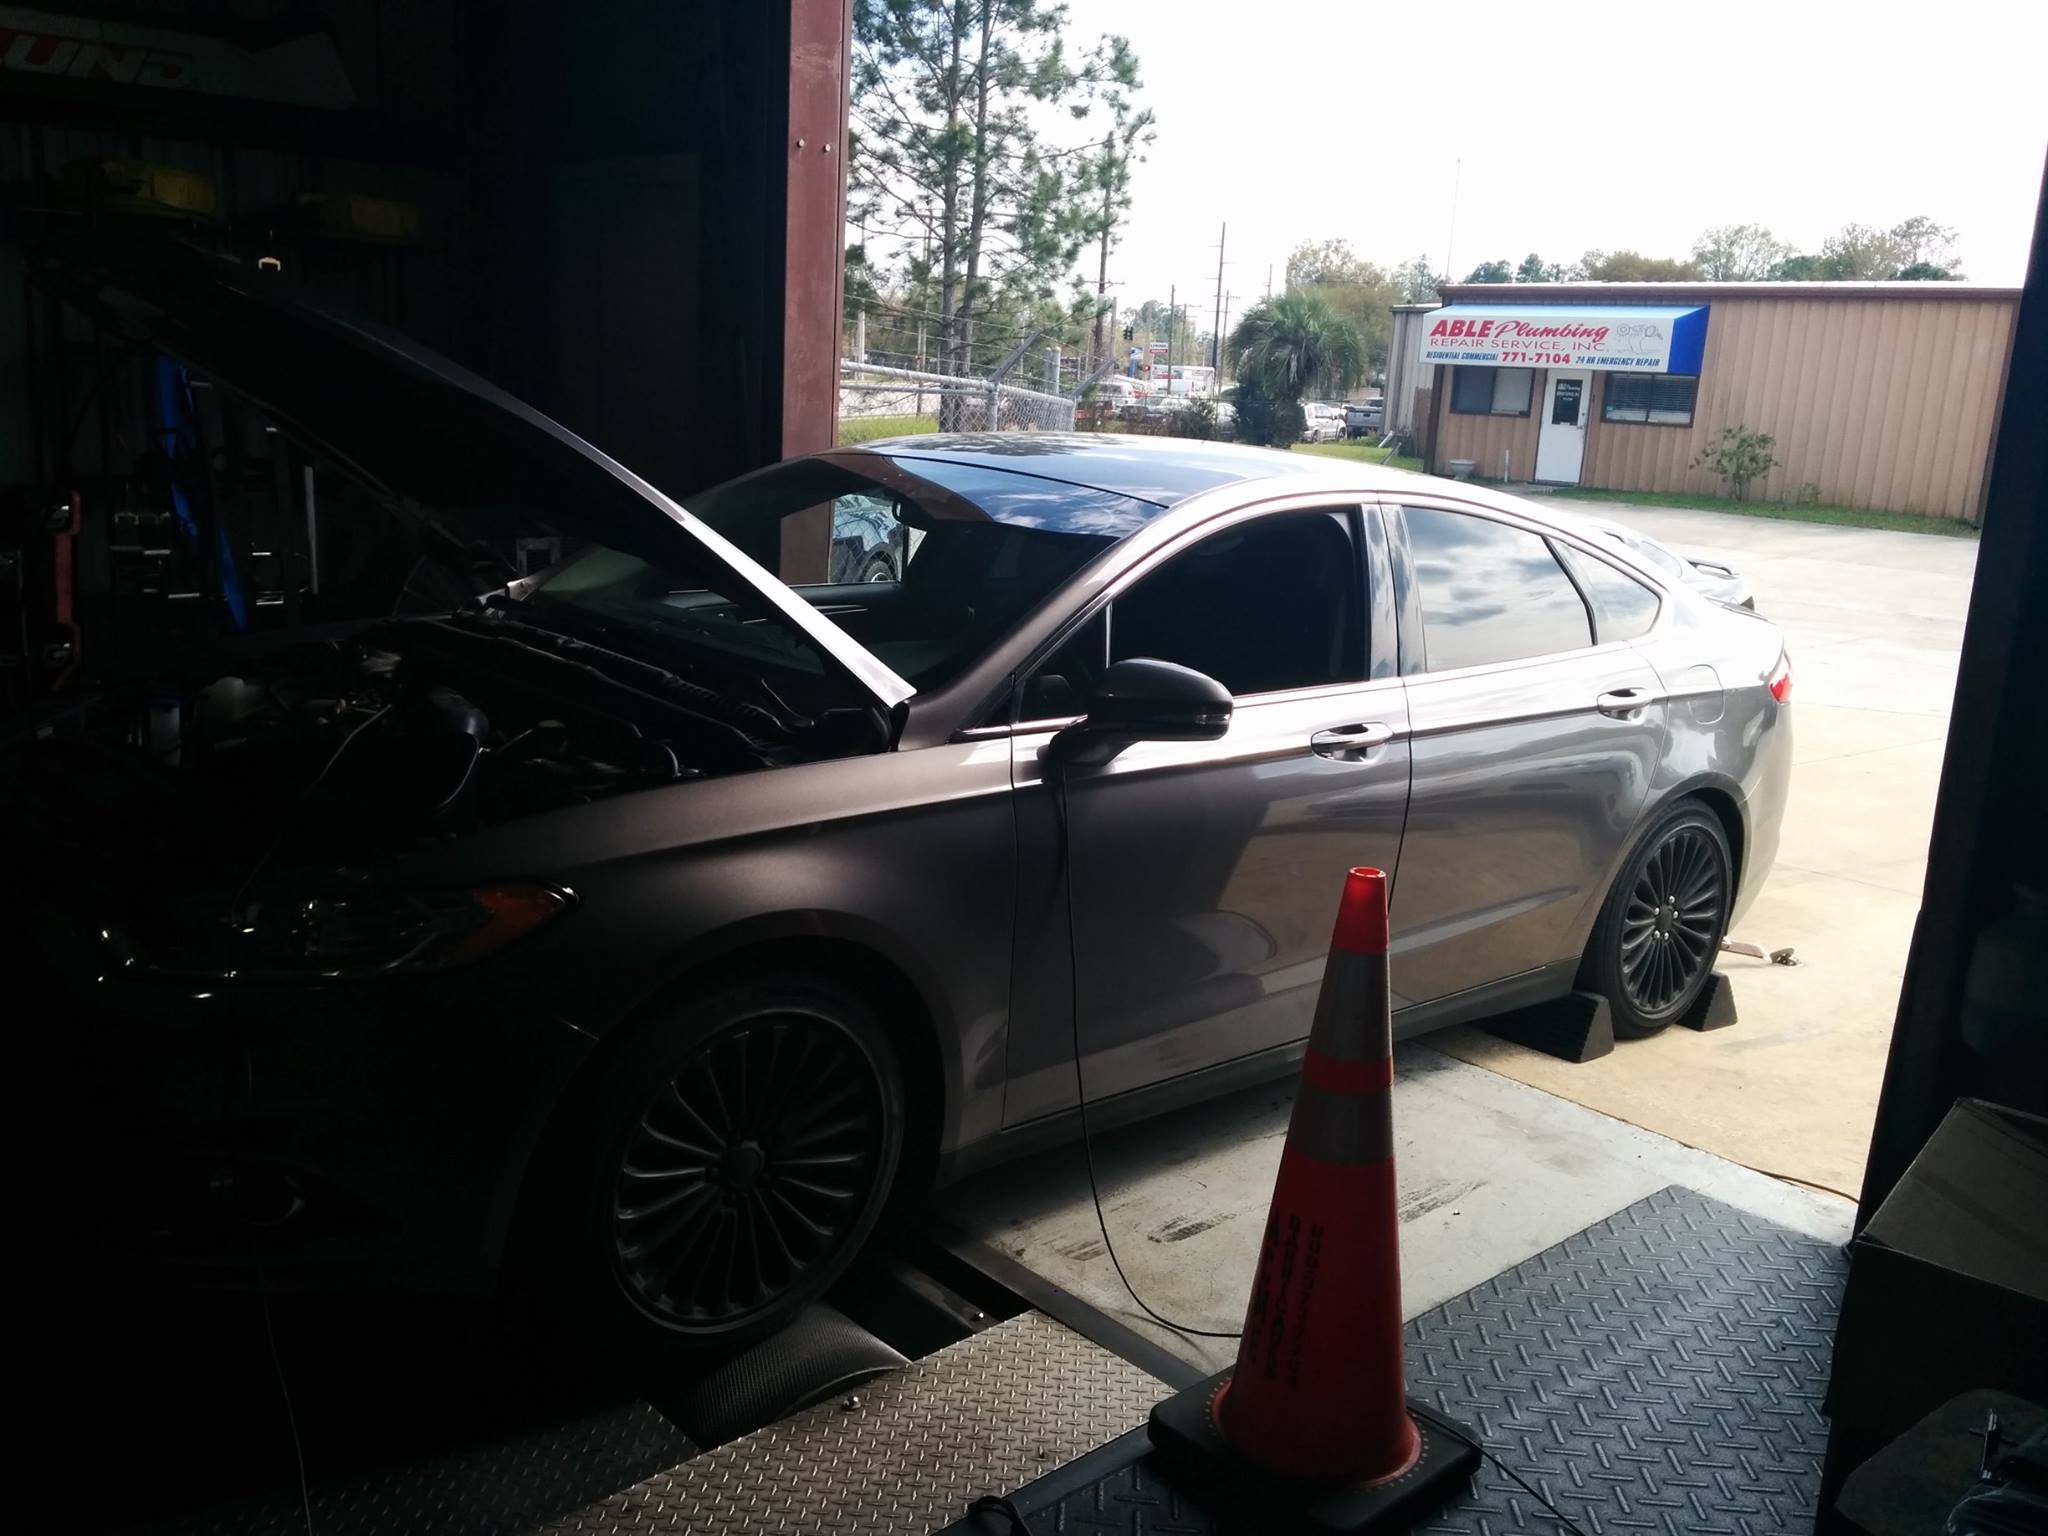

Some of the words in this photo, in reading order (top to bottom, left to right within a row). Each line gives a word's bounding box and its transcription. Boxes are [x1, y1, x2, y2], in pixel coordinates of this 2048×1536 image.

[1429, 319, 1495, 337] ABLE
[1494, 320, 1610, 343] Plumbing
[1430, 338, 1485, 347] REPAIR
[1490, 339, 1566, 351] SERVICE,
[1572, 342, 1610, 352] INC.
[1461, 352, 1499, 361] COMMERCIAL
[1502, 351, 1571, 364] 771-7104
[1597, 356, 1635, 366] EMERGENCY
[1635, 357, 1661, 367] REPAIR
